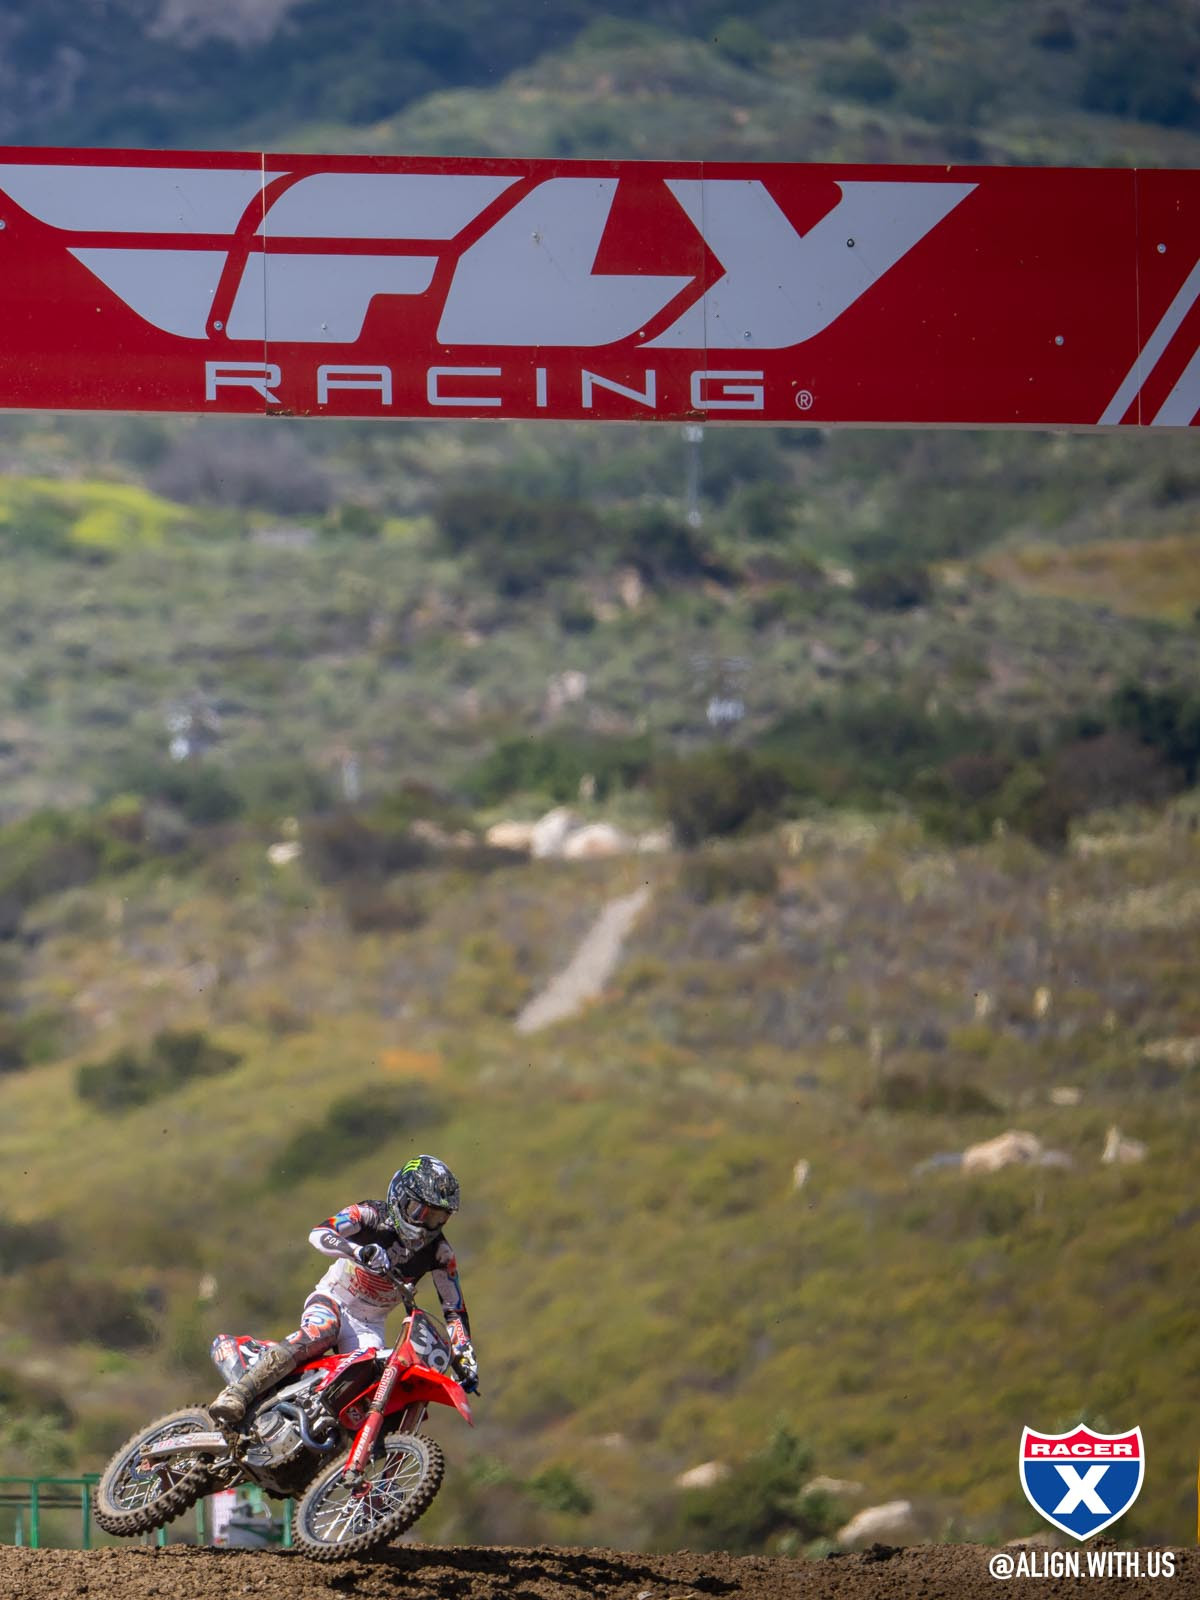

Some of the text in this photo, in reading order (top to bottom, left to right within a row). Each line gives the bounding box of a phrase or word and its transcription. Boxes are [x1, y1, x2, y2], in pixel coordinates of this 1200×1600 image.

[204, 361, 765, 411] RACING
[323, 1234, 342, 1248] FOX
[374, 1366, 395, 1401] SHOWA
[353, 1425, 371, 1462] DUNLOP
